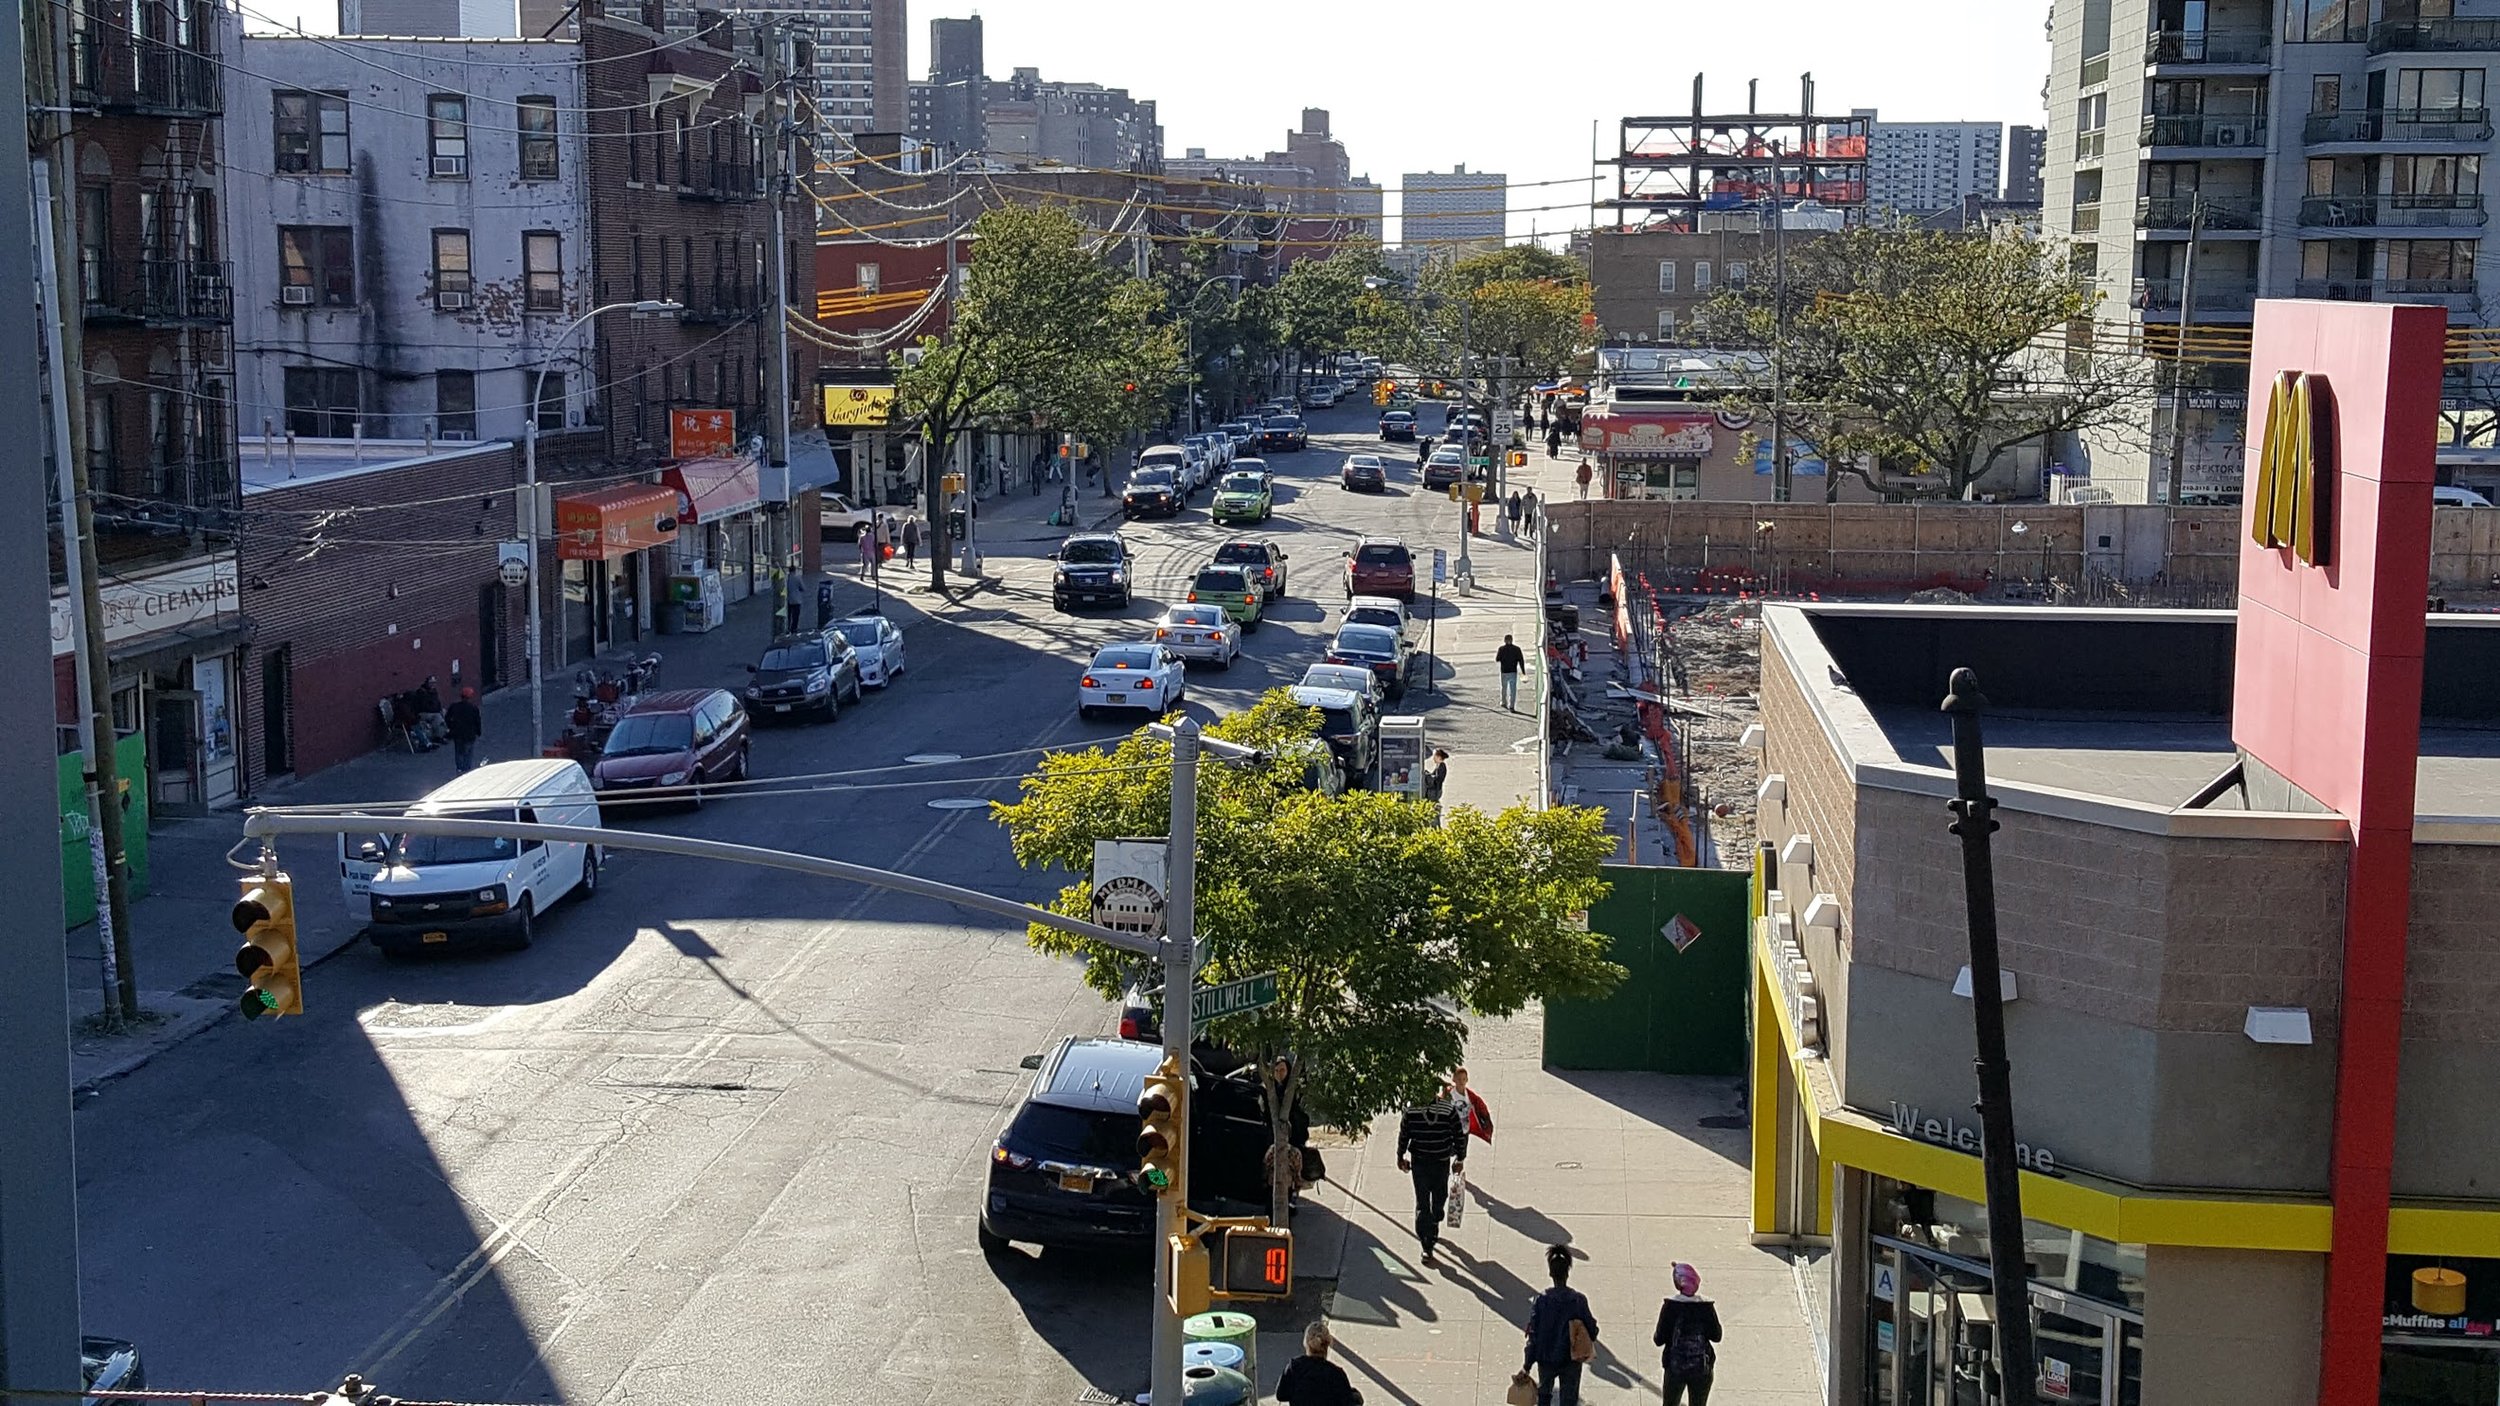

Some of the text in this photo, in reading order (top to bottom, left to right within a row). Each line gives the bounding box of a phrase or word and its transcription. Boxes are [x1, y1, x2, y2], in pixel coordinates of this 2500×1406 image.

[2188, 398, 2240, 409] MOUNT SINAI
[1495, 424, 1511, 434] 25
[2189, 464, 2234, 474] SPEKTOR
[145, 577, 236, 617] CLEANERS
[1097, 878, 1161, 904] MERMAID
[1192, 976, 1275, 1019] STILLWELL AV
[1889, 1099, 2055, 1173] Welcme
[1265, 1248, 1286, 1285] 10
[1878, 1269, 1893, 1292] A
[2047, 1371, 2067, 1385] LOOK
